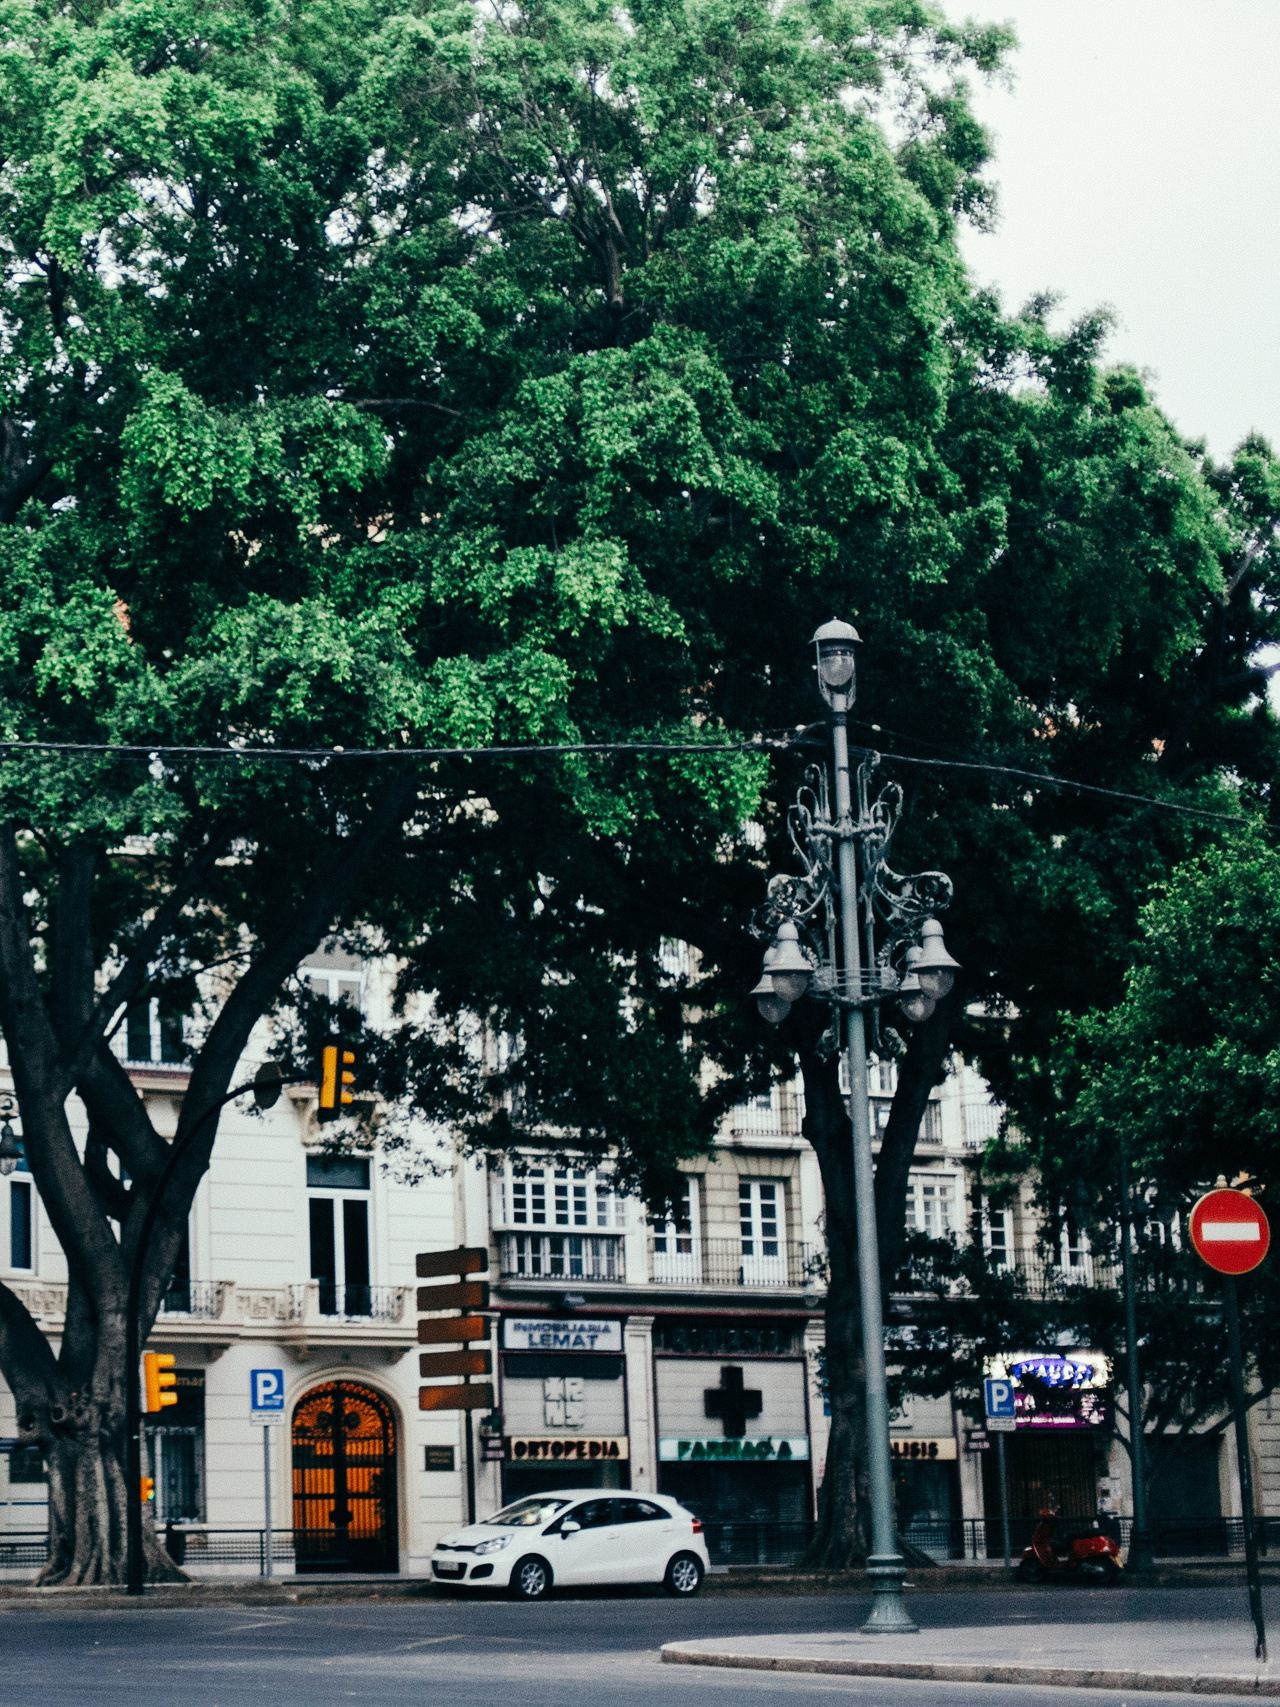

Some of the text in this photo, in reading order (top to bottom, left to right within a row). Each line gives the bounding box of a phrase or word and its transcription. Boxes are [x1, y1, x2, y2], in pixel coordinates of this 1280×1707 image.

[513, 1322, 611, 1333] INMOBILIARIA
[528, 1333, 599, 1348] LEMAT
[256, 1372, 278, 1407] P
[991, 1382, 1009, 1412] P
[514, 1440, 620, 1458] ORTOPEDIA
